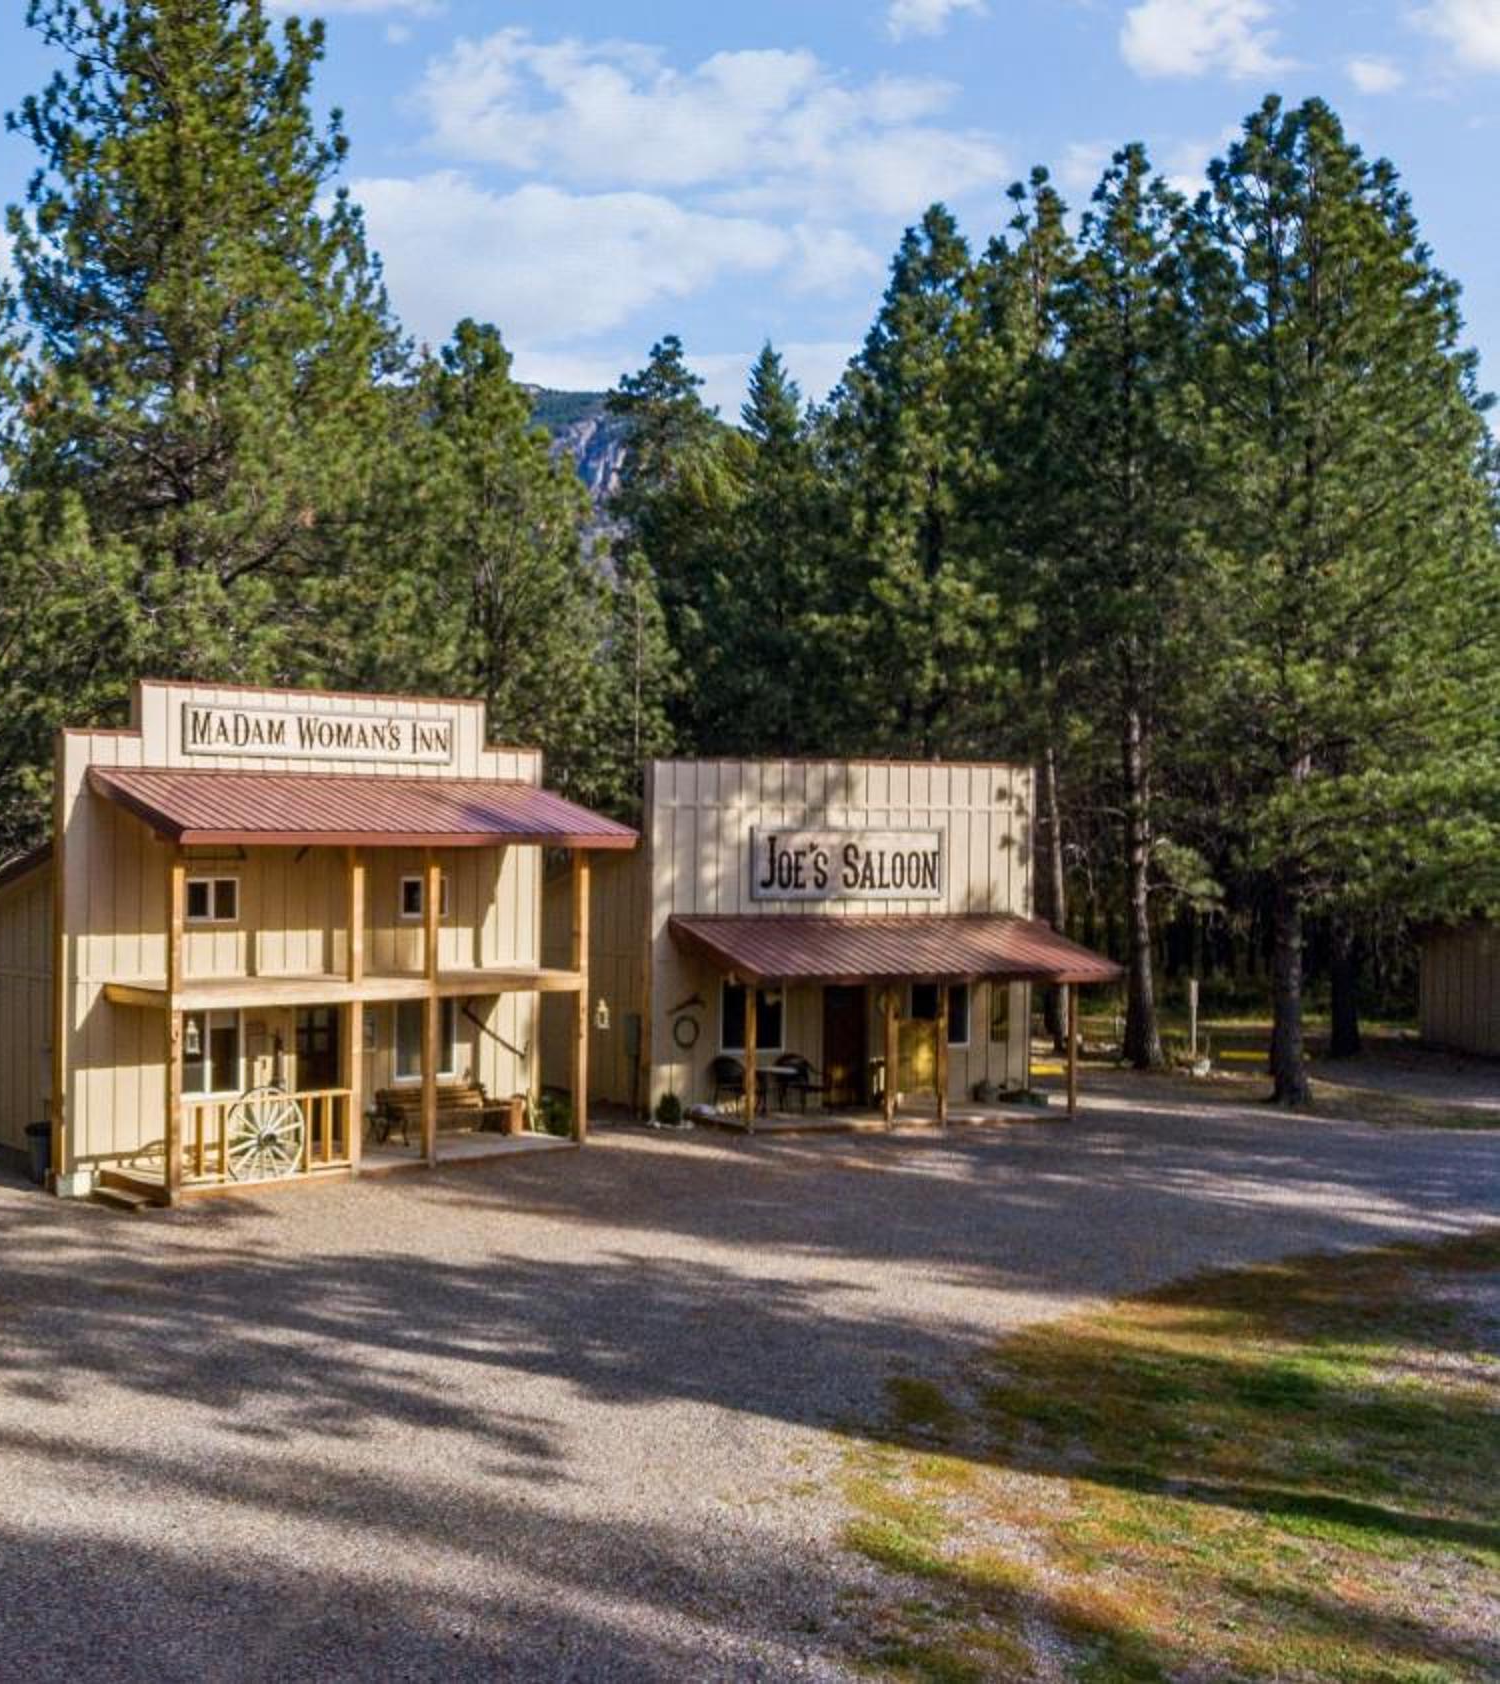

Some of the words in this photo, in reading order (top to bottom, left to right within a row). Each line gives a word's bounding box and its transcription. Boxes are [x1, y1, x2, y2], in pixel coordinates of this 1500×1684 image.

[191, 710, 285, 747] MADAM
[297, 715, 401, 751] WOMAN'S
[412, 721, 448, 754] INN
[760, 836, 829, 889] JOE'S
[842, 842, 940, 890] SALOON
